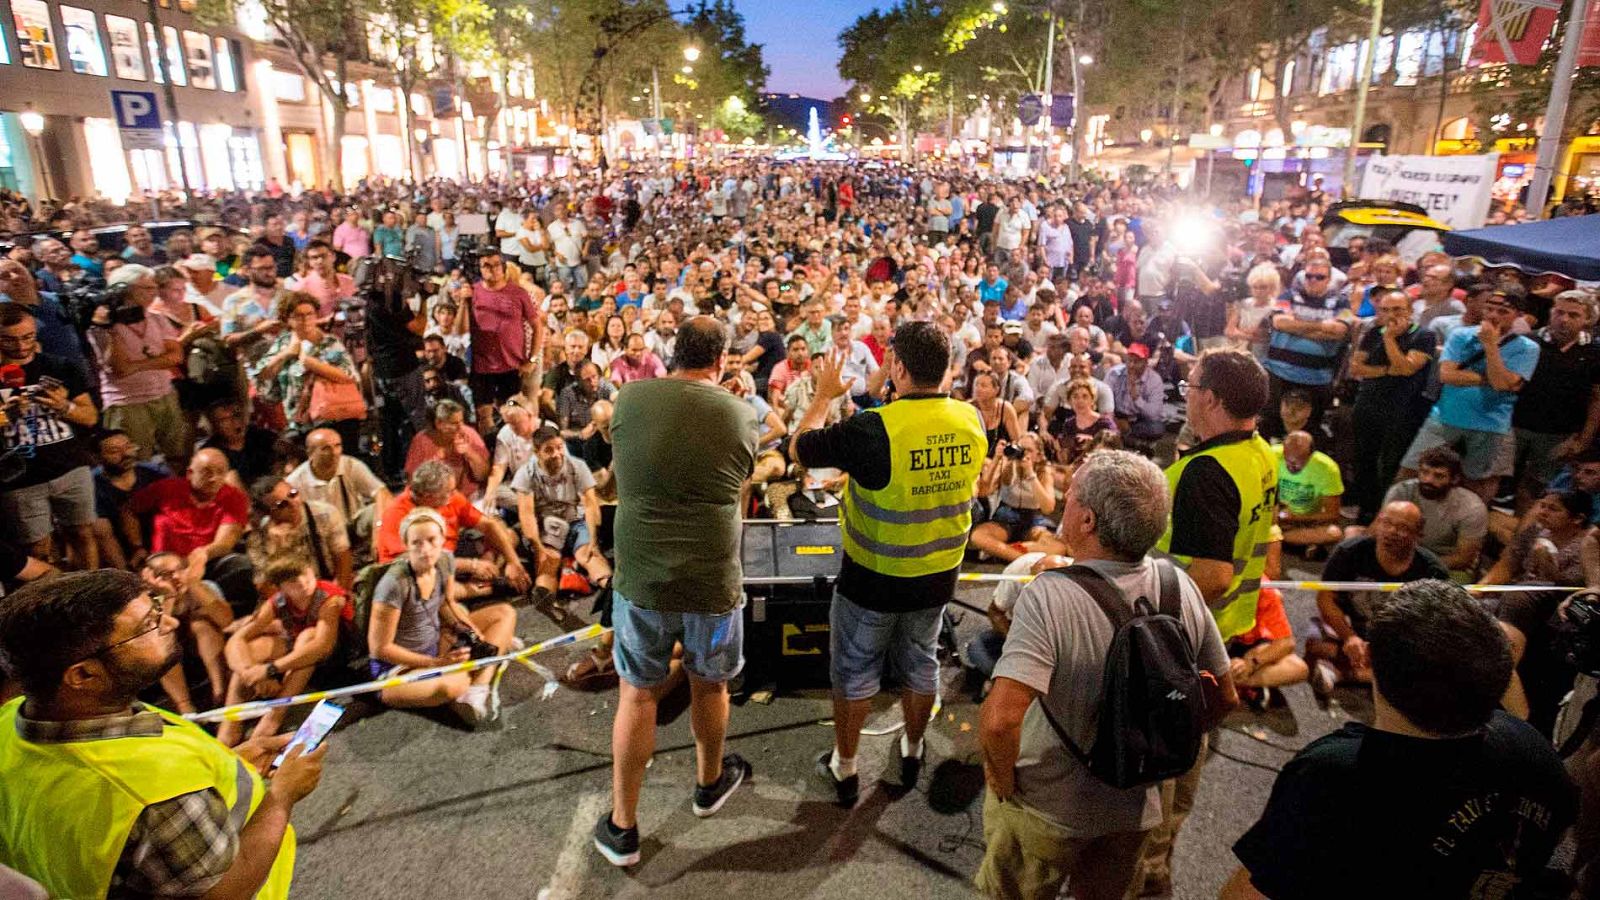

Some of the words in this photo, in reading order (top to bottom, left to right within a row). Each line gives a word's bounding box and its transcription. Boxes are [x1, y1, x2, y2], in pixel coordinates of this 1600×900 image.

[121, 94, 151, 126] P
[926, 433, 957, 445] STAFF
[909, 444, 972, 471] ELITE
[929, 470, 951, 482] TAXI
